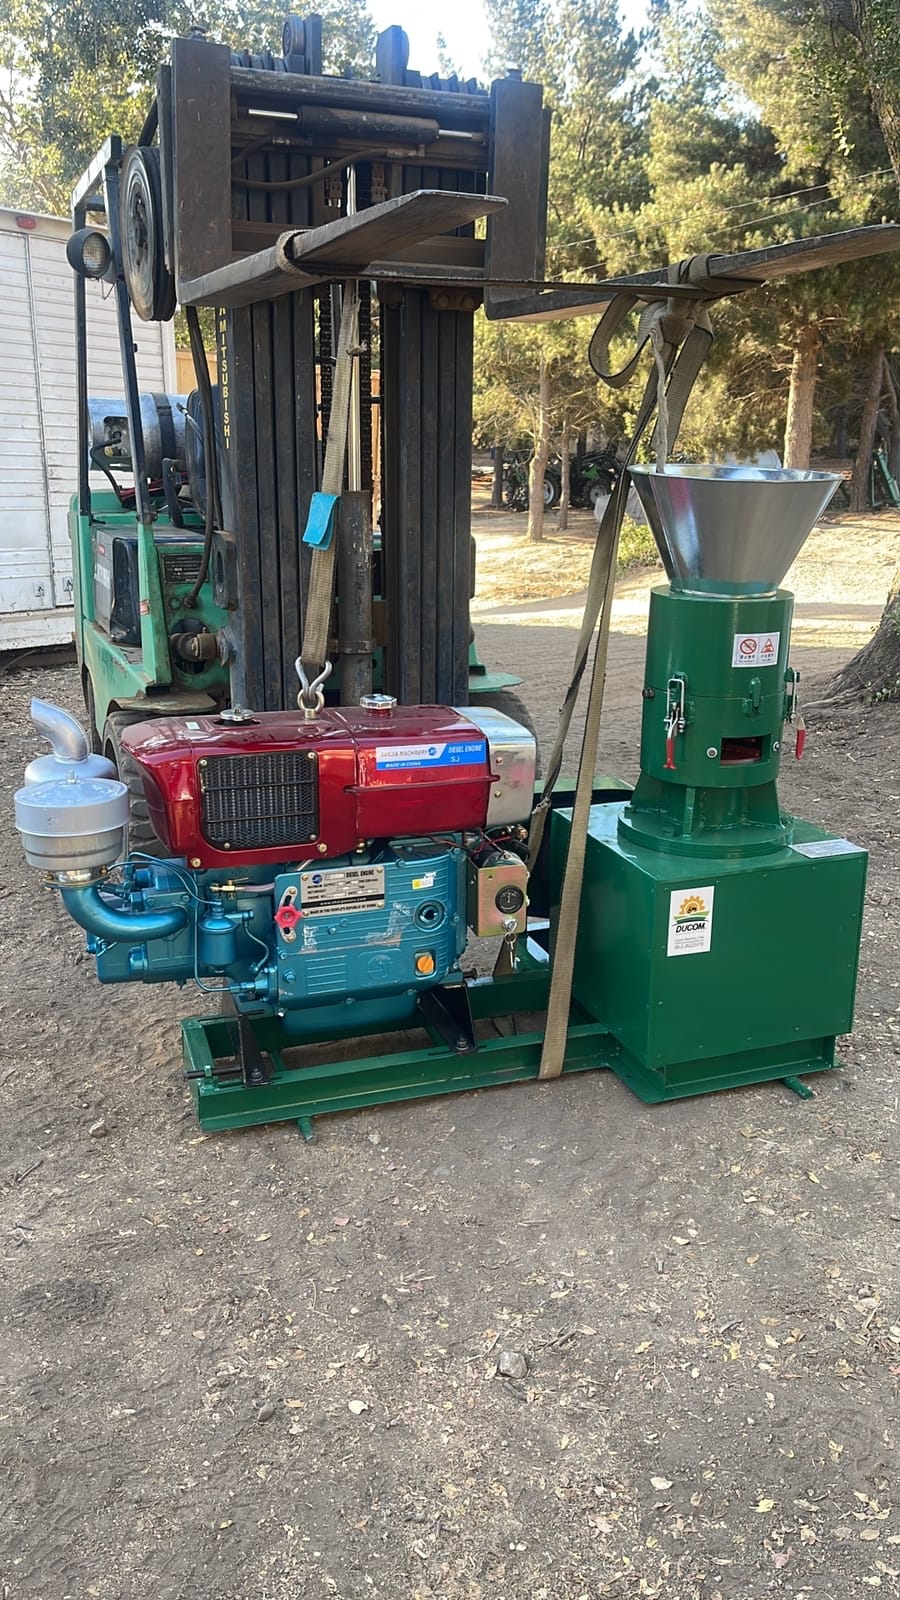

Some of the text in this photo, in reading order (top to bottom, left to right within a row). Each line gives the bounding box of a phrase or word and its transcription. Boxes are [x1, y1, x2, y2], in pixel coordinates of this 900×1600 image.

[220, 319, 230, 449] MITSUBISHI
[448, 744, 482, 754] DIESEL ENGINE
[450, 755, 460, 763] SJ
[360, 869, 374, 877] ENGINE
[675, 922, 705, 933] DUCOM
